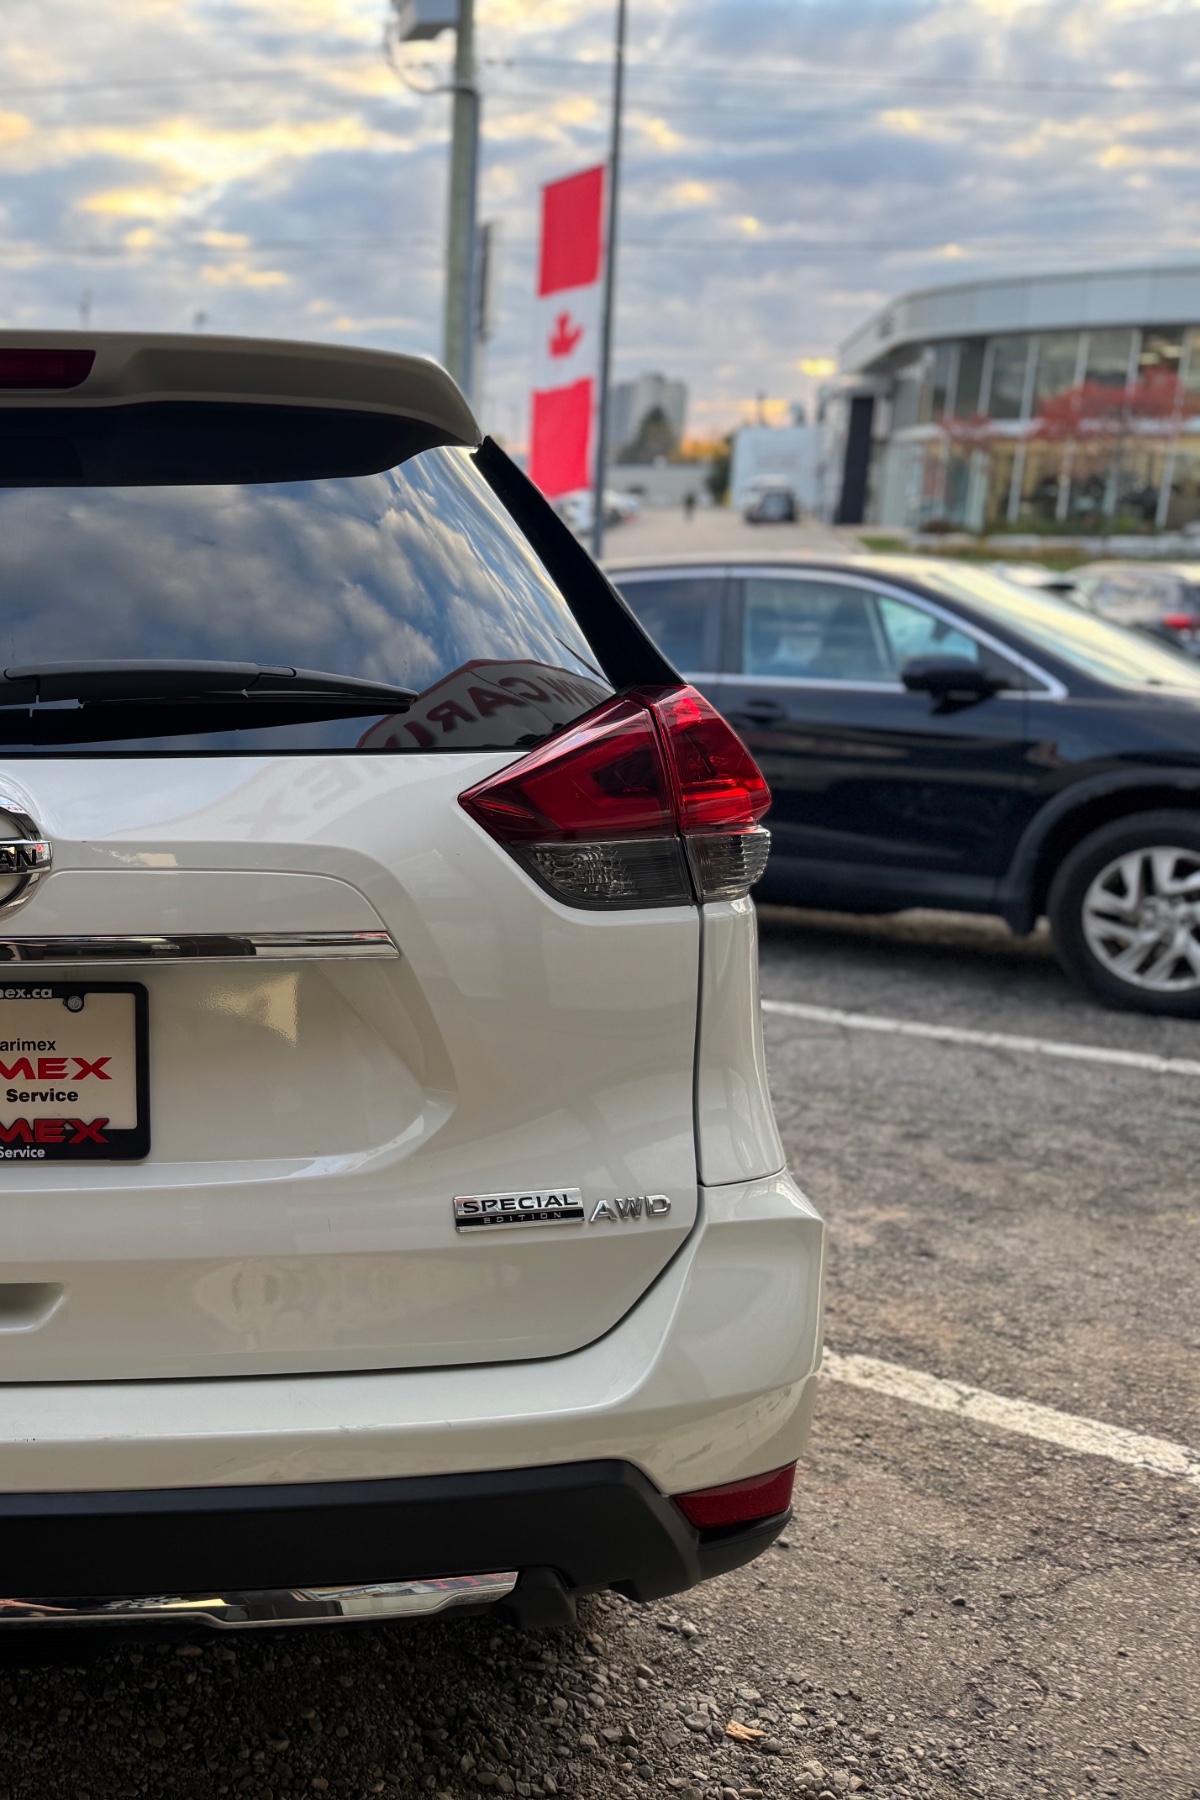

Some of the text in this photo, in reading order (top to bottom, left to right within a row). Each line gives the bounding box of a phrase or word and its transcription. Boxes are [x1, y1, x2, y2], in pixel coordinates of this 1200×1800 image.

[6, 1088, 79, 1103] Service
[463, 1193, 579, 1214] SPECIAL
[589, 1194, 672, 1223] AWD
[483, 1211, 562, 1224] EDITION
